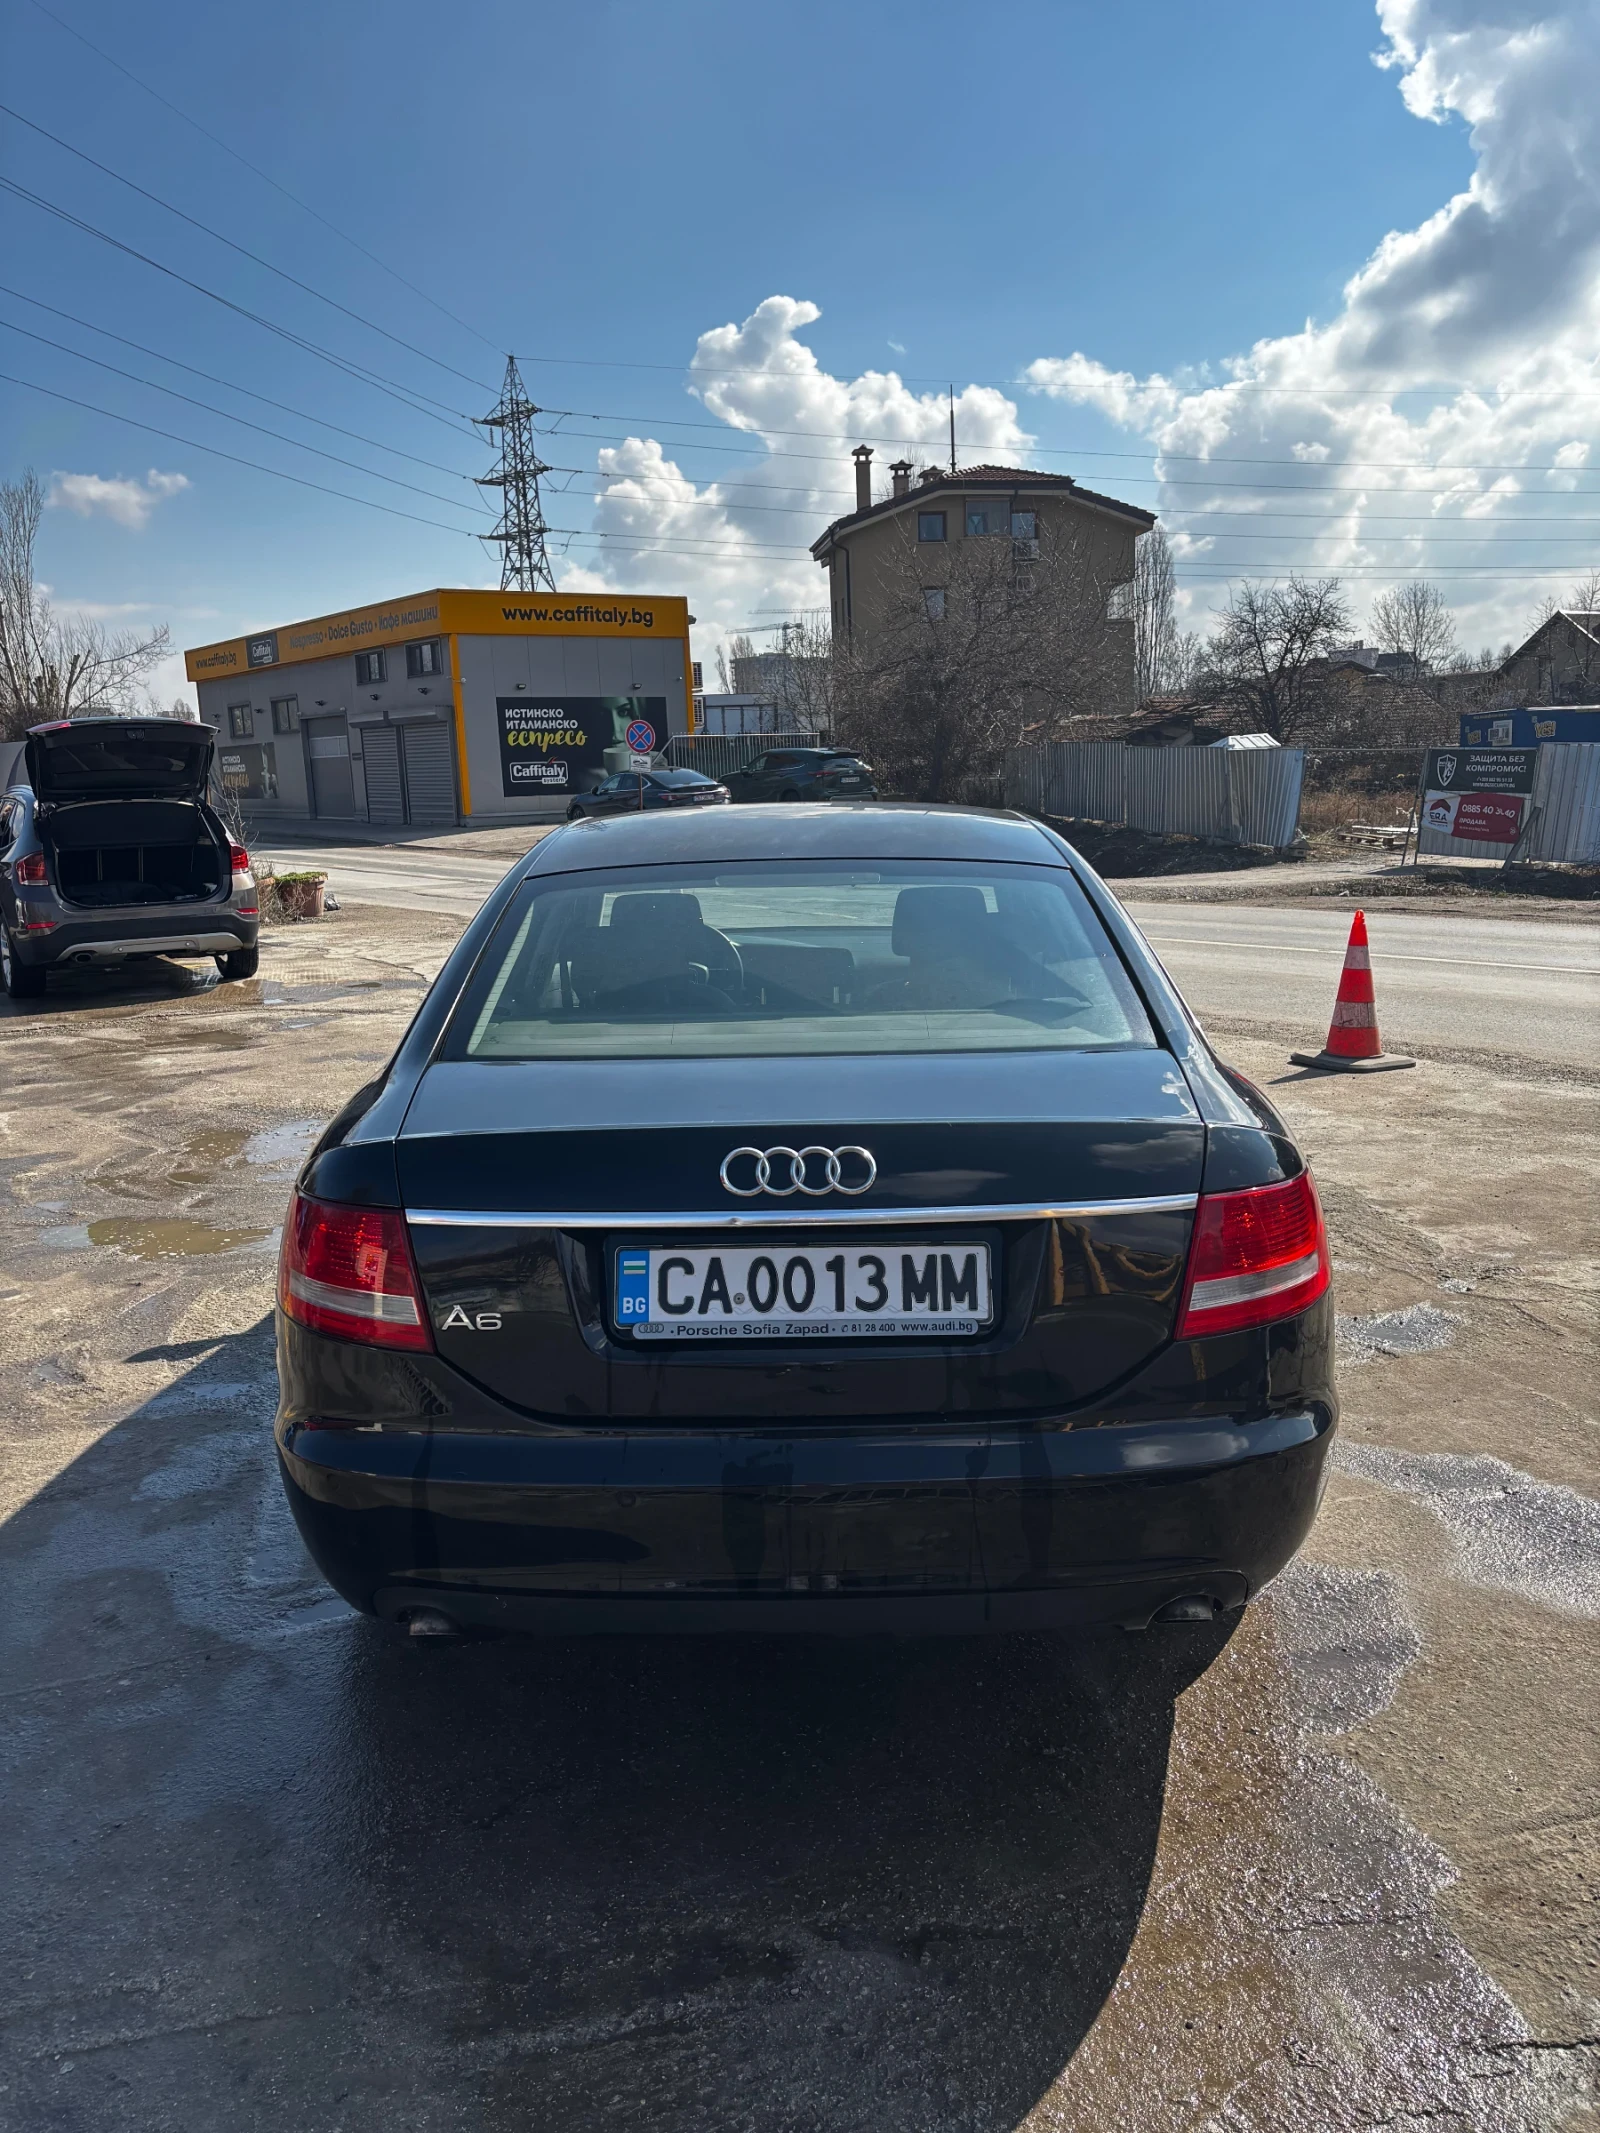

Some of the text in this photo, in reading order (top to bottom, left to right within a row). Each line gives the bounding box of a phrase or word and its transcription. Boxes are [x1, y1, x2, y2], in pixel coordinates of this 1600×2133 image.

[328, 624, 349, 641] Dolce
[350, 620, 373, 637] Gusto
[378, 612, 400, 633] Кафе
[401, 605, 438, 626] машини
[502, 605, 653, 628] www.caffitaly.bg
[505, 708, 564, 718] ИСТИНСКО
[506, 719, 578, 729] ИТАЛИАНСКО
[507, 730, 588, 753] еспресо
[1470, 755, 1525, 763] ЗАЩИТА БЕЗ
[513, 764, 565, 778] Caffitaly
[1465, 765, 1526, 773] КОМПРОМИС!
[1461, 804, 1481, 813] 0885
[1482, 806, 1494, 814] 40
[1429, 812, 1447, 821] ERA
[622, 1297, 646, 1314] BG
[441, 1304, 502, 1331] A6
[677, 1321, 973, 1337] Porsche Sofia Zapad 81 28 400 www.audi.bg
